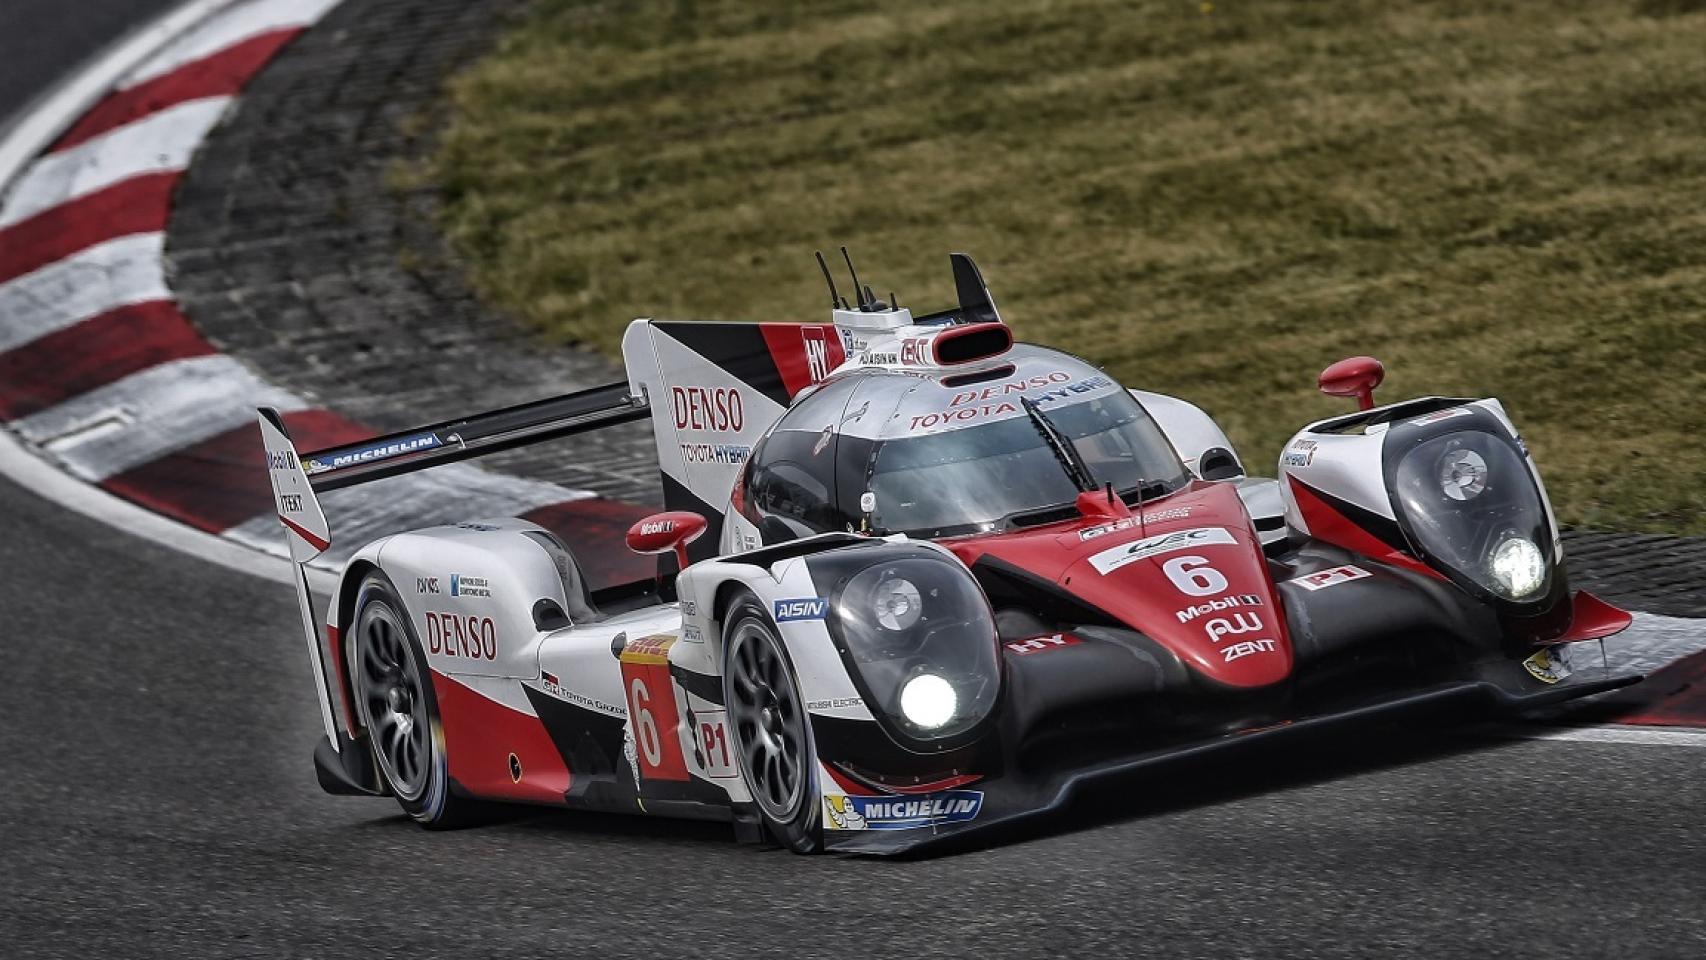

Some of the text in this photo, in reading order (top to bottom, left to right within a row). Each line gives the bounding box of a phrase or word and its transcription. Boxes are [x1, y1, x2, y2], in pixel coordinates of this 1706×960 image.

[804, 339, 827, 382] HY
[950, 371, 1072, 408] DENSO
[672, 387, 744, 432] DENSO
[909, 403, 1017, 430] TOYOTA
[333, 437, 433, 465] MICHELIN
[682, 445, 714, 462] TOYOTA
[641, 522, 663, 536] Mobil
[1162, 556, 1228, 597] 6
[1304, 568, 1358, 586] P1
[778, 602, 823, 617] AISIN
[1176, 596, 1239, 623] Mobil
[425, 611, 497, 660] DENSO
[1007, 634, 1066, 653] HY
[1219, 639, 1275, 662] ZENT
[632, 678, 661, 767] 6
[701, 723, 729, 767] P1
[865, 799, 977, 819] MICHELIN
